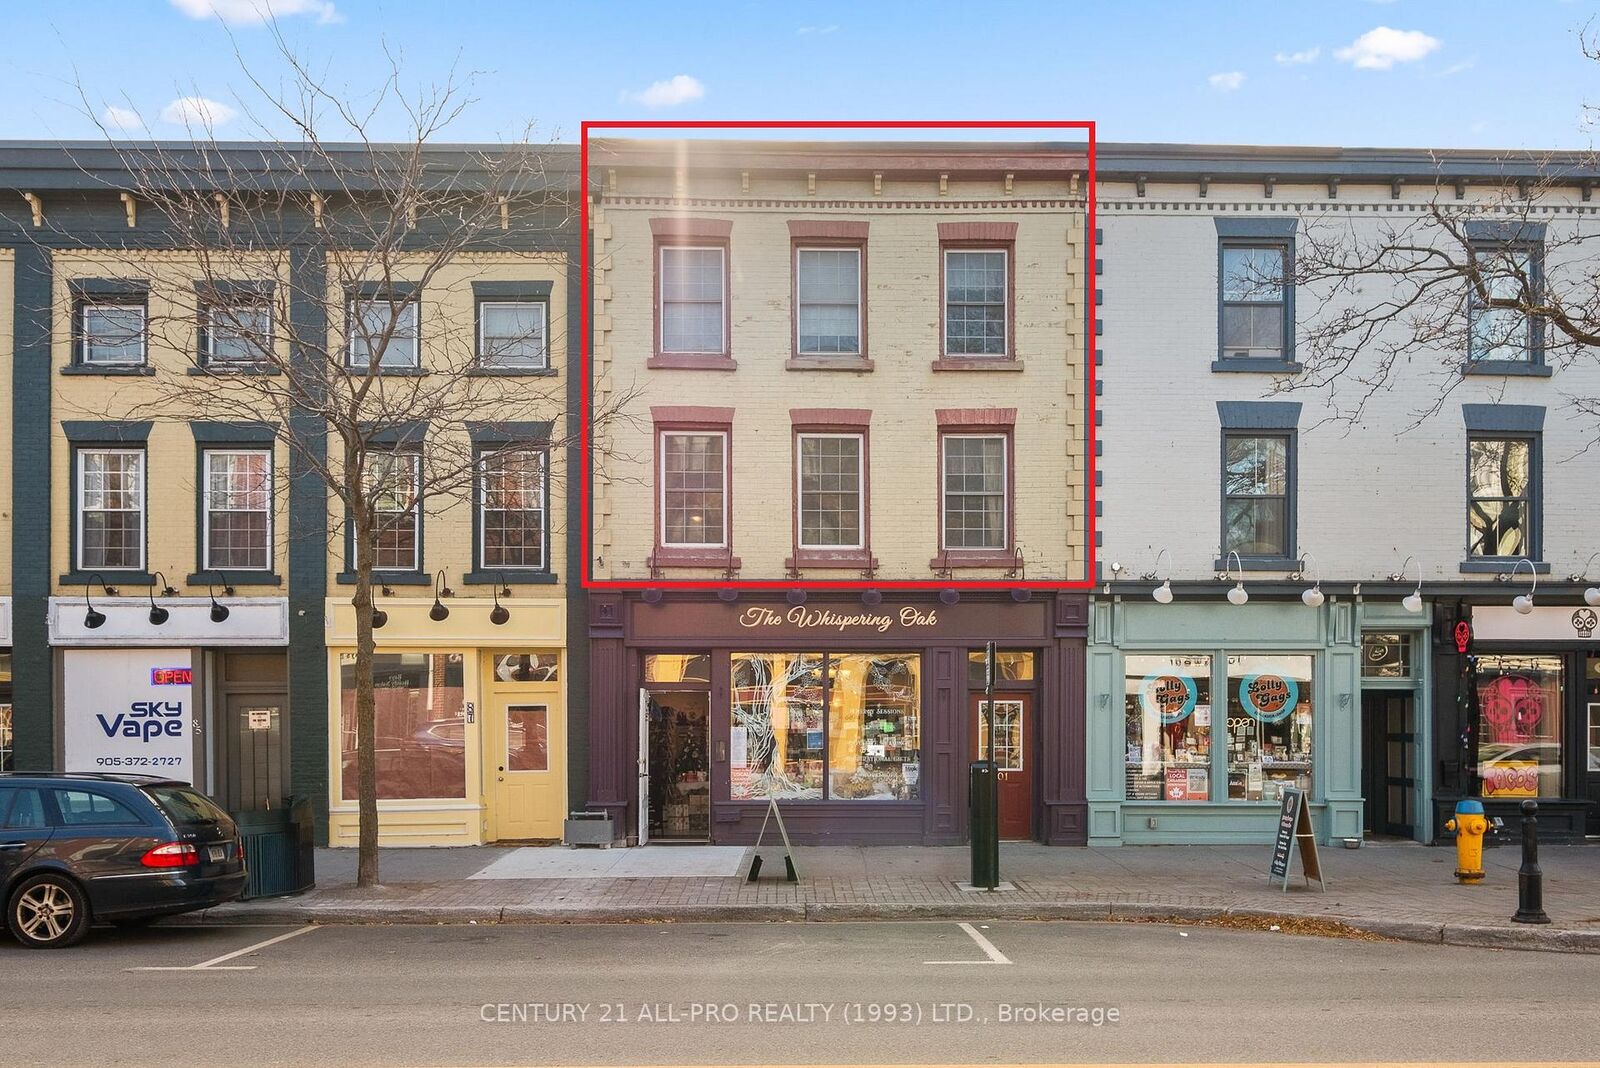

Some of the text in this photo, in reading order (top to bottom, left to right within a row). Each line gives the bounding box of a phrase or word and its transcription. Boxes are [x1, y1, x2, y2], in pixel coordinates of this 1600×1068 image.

[740, 605, 937, 632] The Whispering Oak
[153, 670, 192, 684] OPEN
[1248, 679, 1282, 695] Lolly
[1156, 692, 1190, 706] Gags
[1256, 692, 1291, 707] Gags
[129, 701, 182, 718] SKY
[96, 713, 183, 743] Vape
[1226, 718, 1255, 733] open
[96, 757, 182, 766] 905-372-2727
[1483, 767, 1537, 795] TACOS
